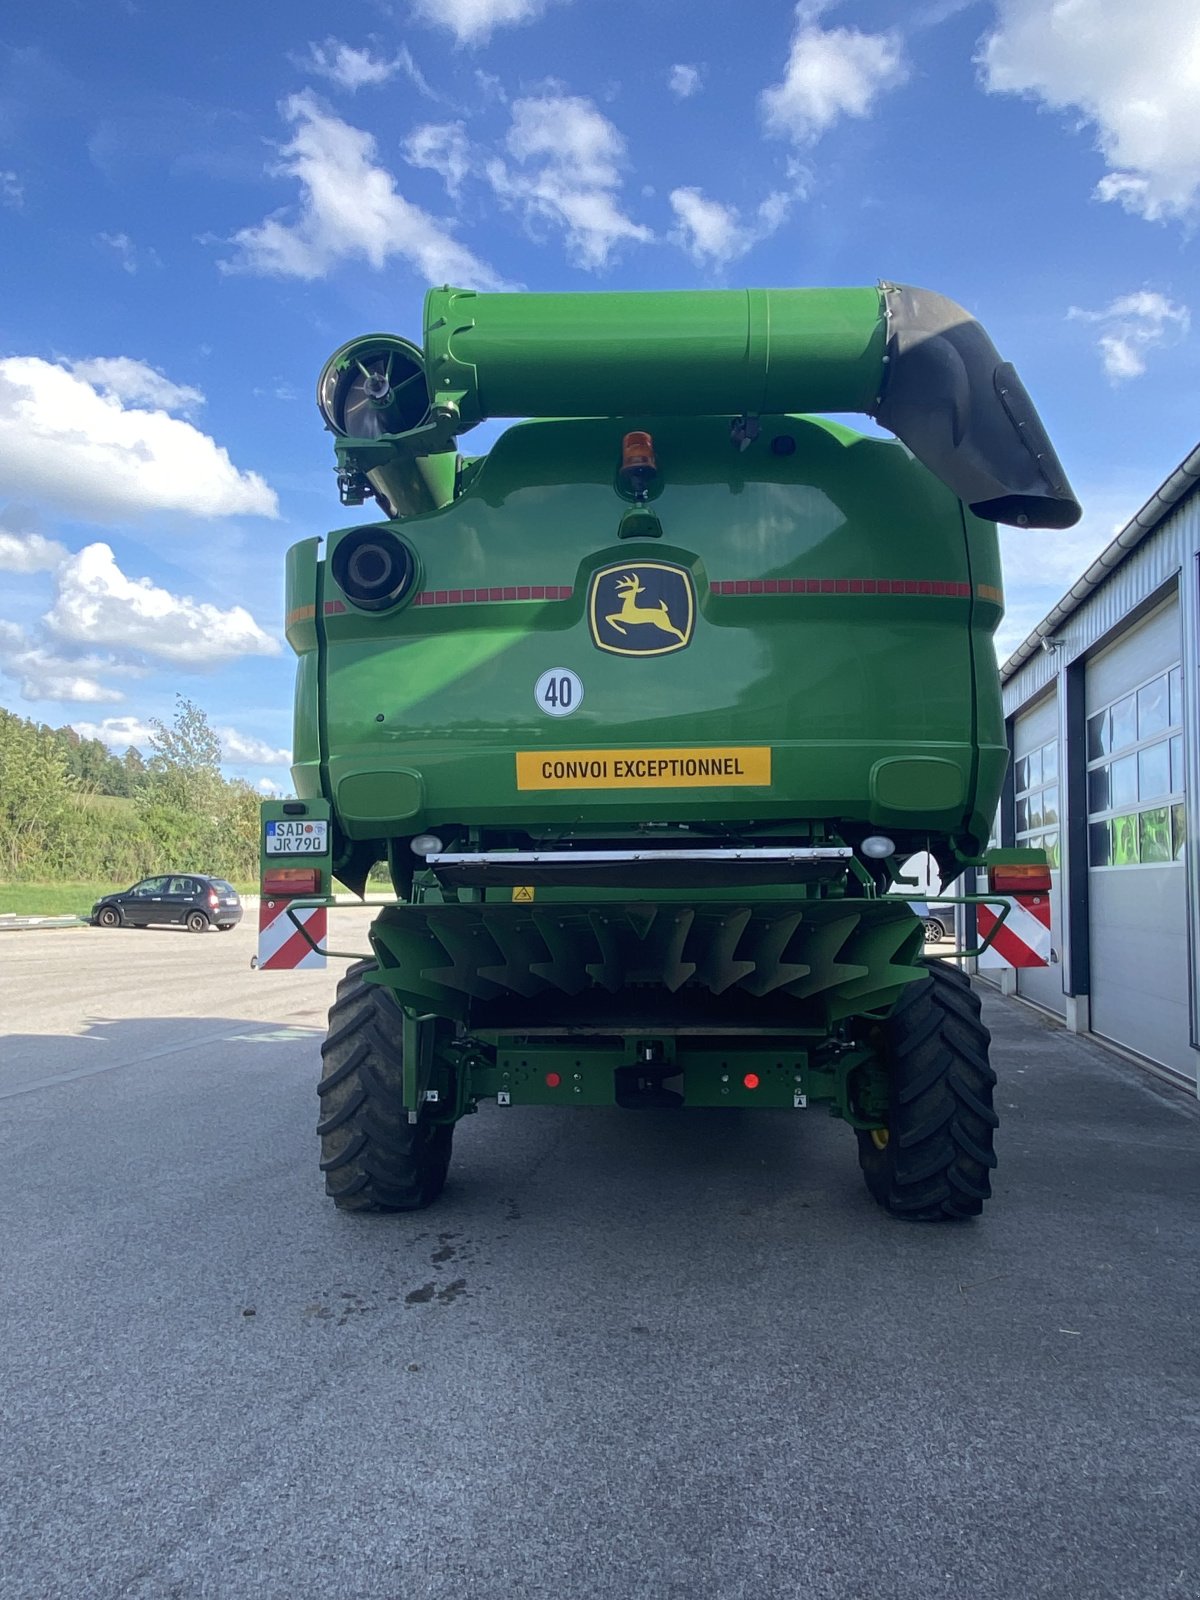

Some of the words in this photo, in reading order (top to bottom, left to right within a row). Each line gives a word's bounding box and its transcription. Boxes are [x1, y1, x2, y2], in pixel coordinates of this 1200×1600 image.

[545, 677, 572, 707] 40
[542, 761, 608, 779] CONVOI
[614, 757, 744, 778] EXCEPTIONNEL
[277, 823, 304, 837] SAD
[274, 837, 291, 851] JR
[295, 837, 321, 851] 790
